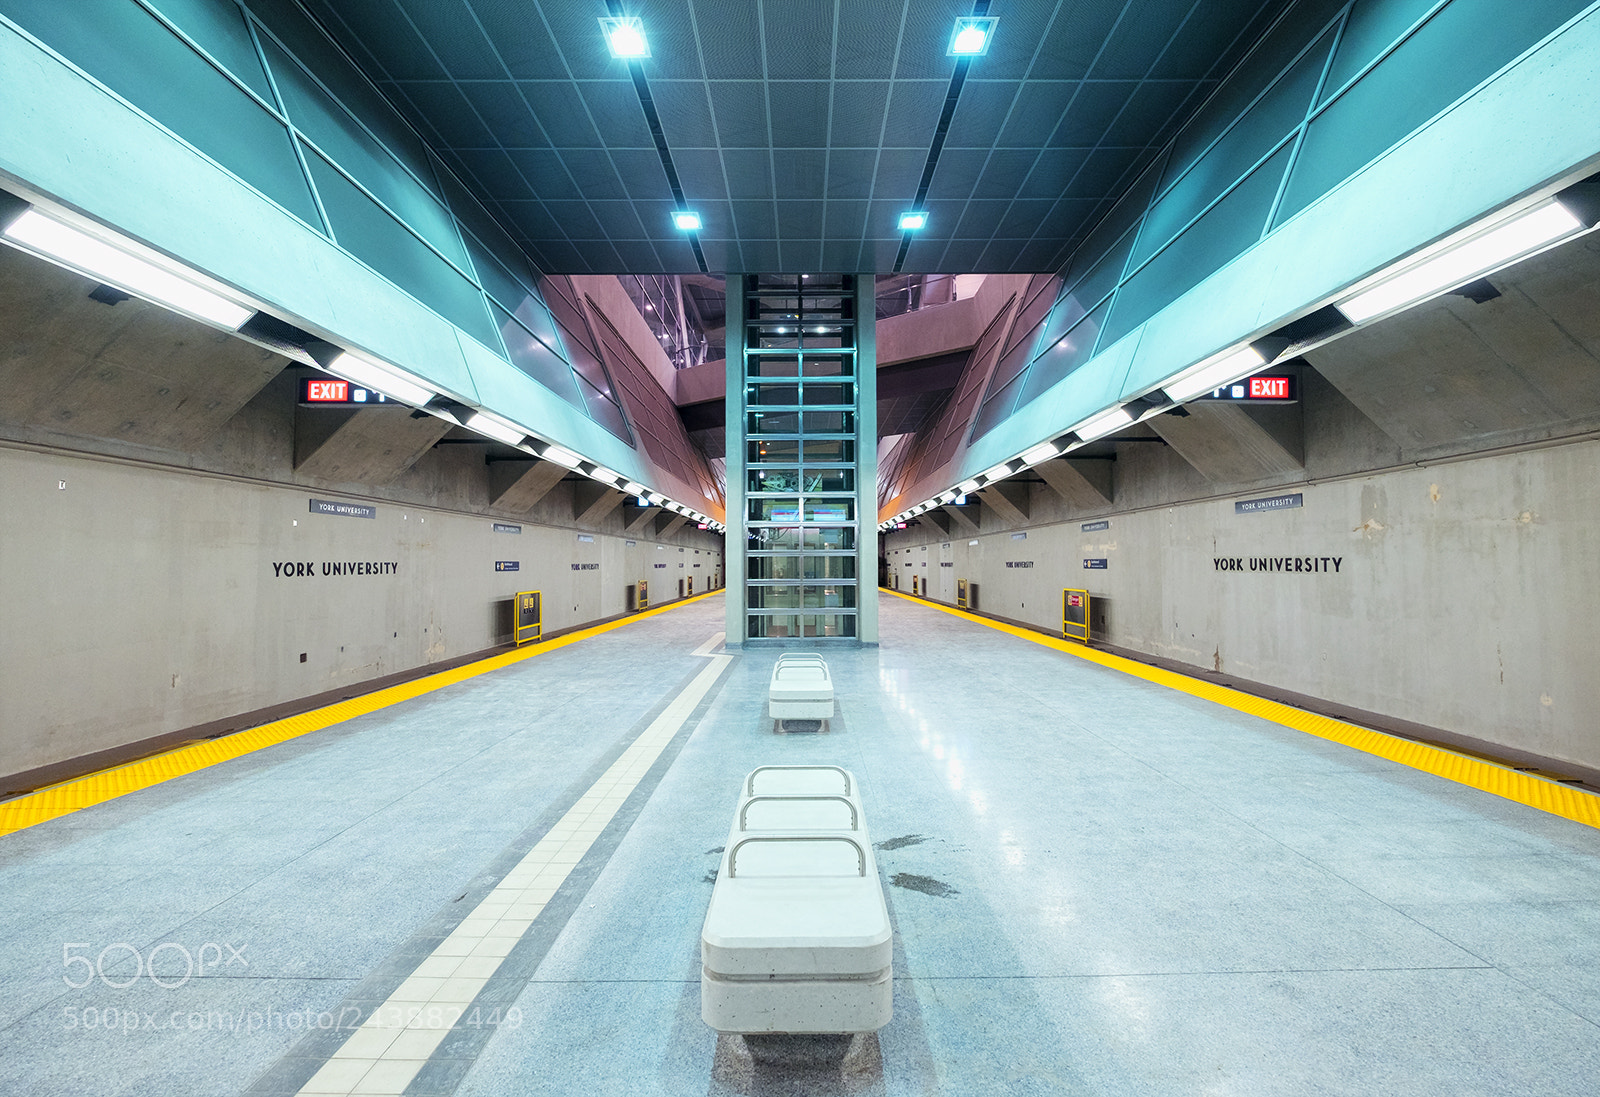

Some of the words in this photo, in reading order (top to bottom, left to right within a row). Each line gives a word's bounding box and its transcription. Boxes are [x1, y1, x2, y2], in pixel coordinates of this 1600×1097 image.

[310, 383, 346, 399] EXIT
[1251, 380, 1286, 396] EXIT
[318, 503, 335, 512] YORK
[336, 504, 370, 515] UNIVERSITY
[1241, 502, 1256, 511] YORK
[1257, 498, 1294, 508] UNIVERSITY
[272, 562, 315, 578] YORK
[322, 562, 398, 576] UNIVERSITY
[1213, 558, 1243, 571] YORK
[1249, 557, 1343, 572] UNIVERSITY
